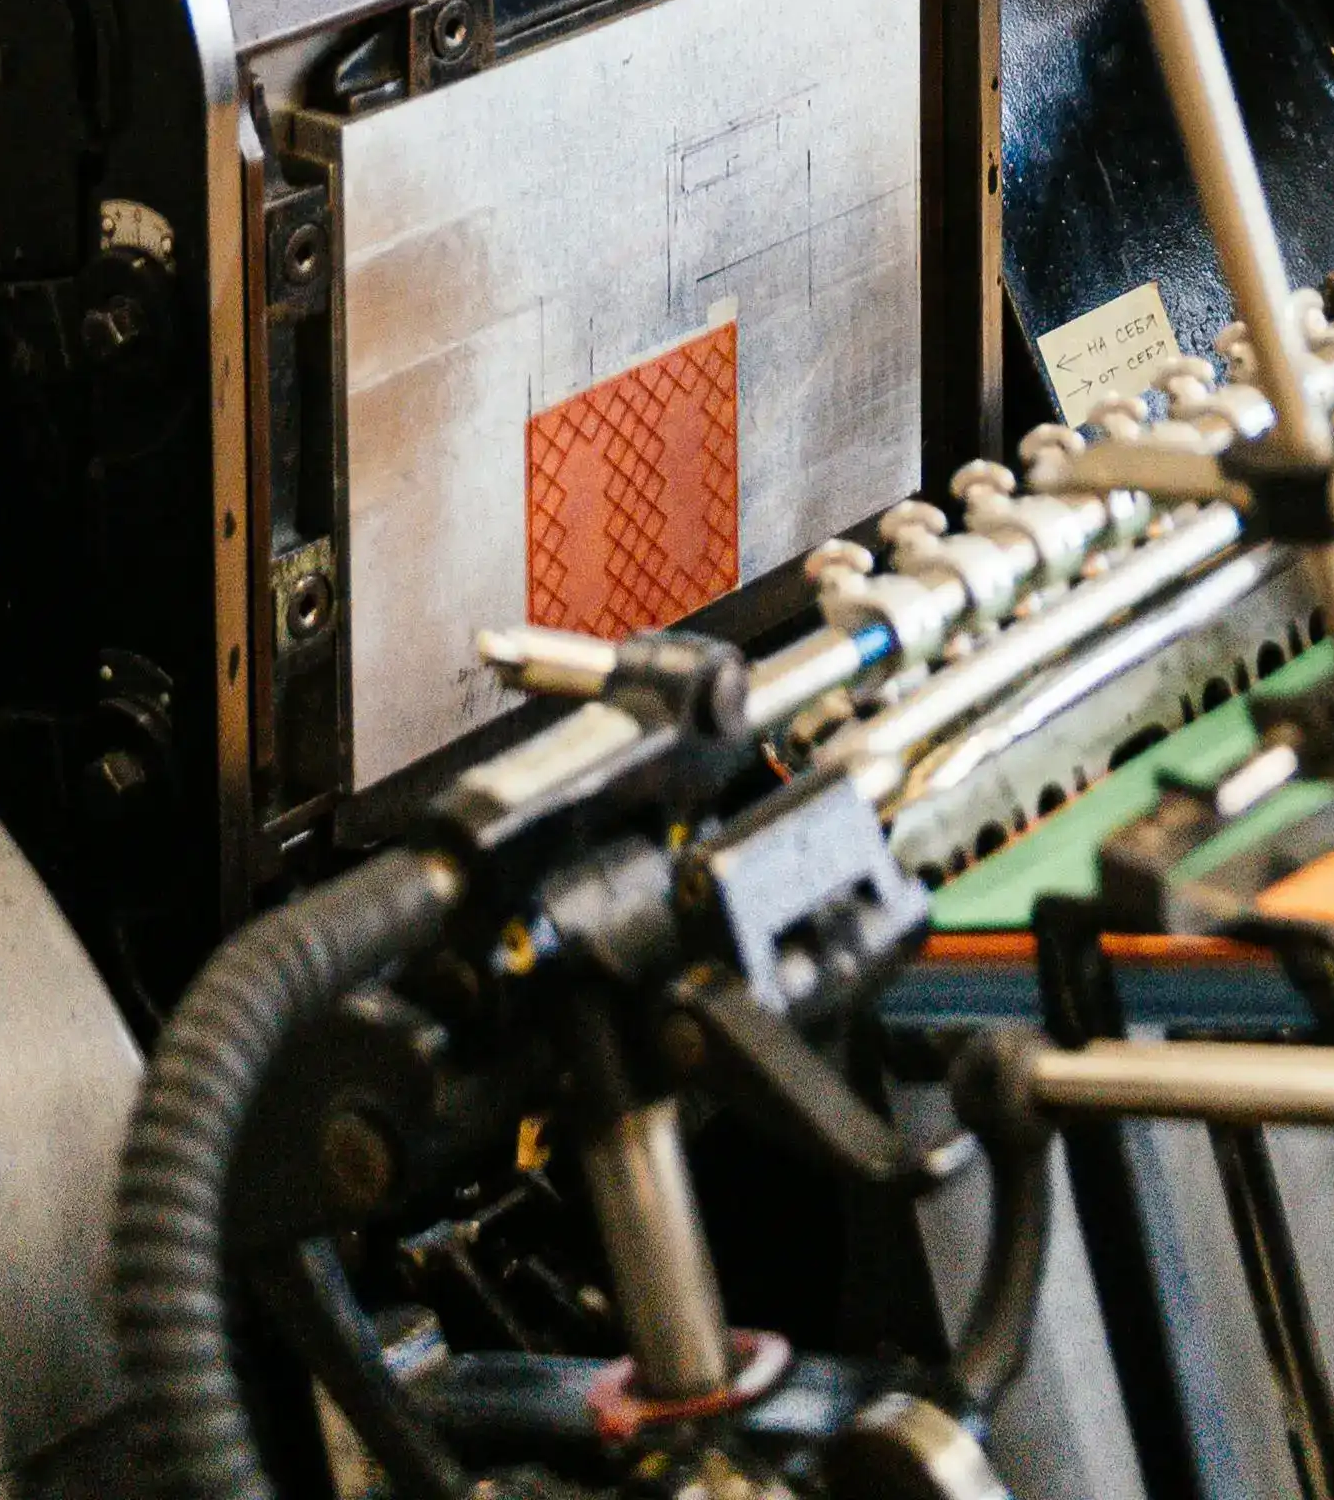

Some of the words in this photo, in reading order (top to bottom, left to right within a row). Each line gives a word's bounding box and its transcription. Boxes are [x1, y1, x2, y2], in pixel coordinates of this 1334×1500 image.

[1087, 336, 1107, 356] НА
[1115, 313, 1158, 344] СЕБЯ
[1098, 366, 1119, 384] ОТ
[1127, 340, 1167, 370] СЕБЯ
